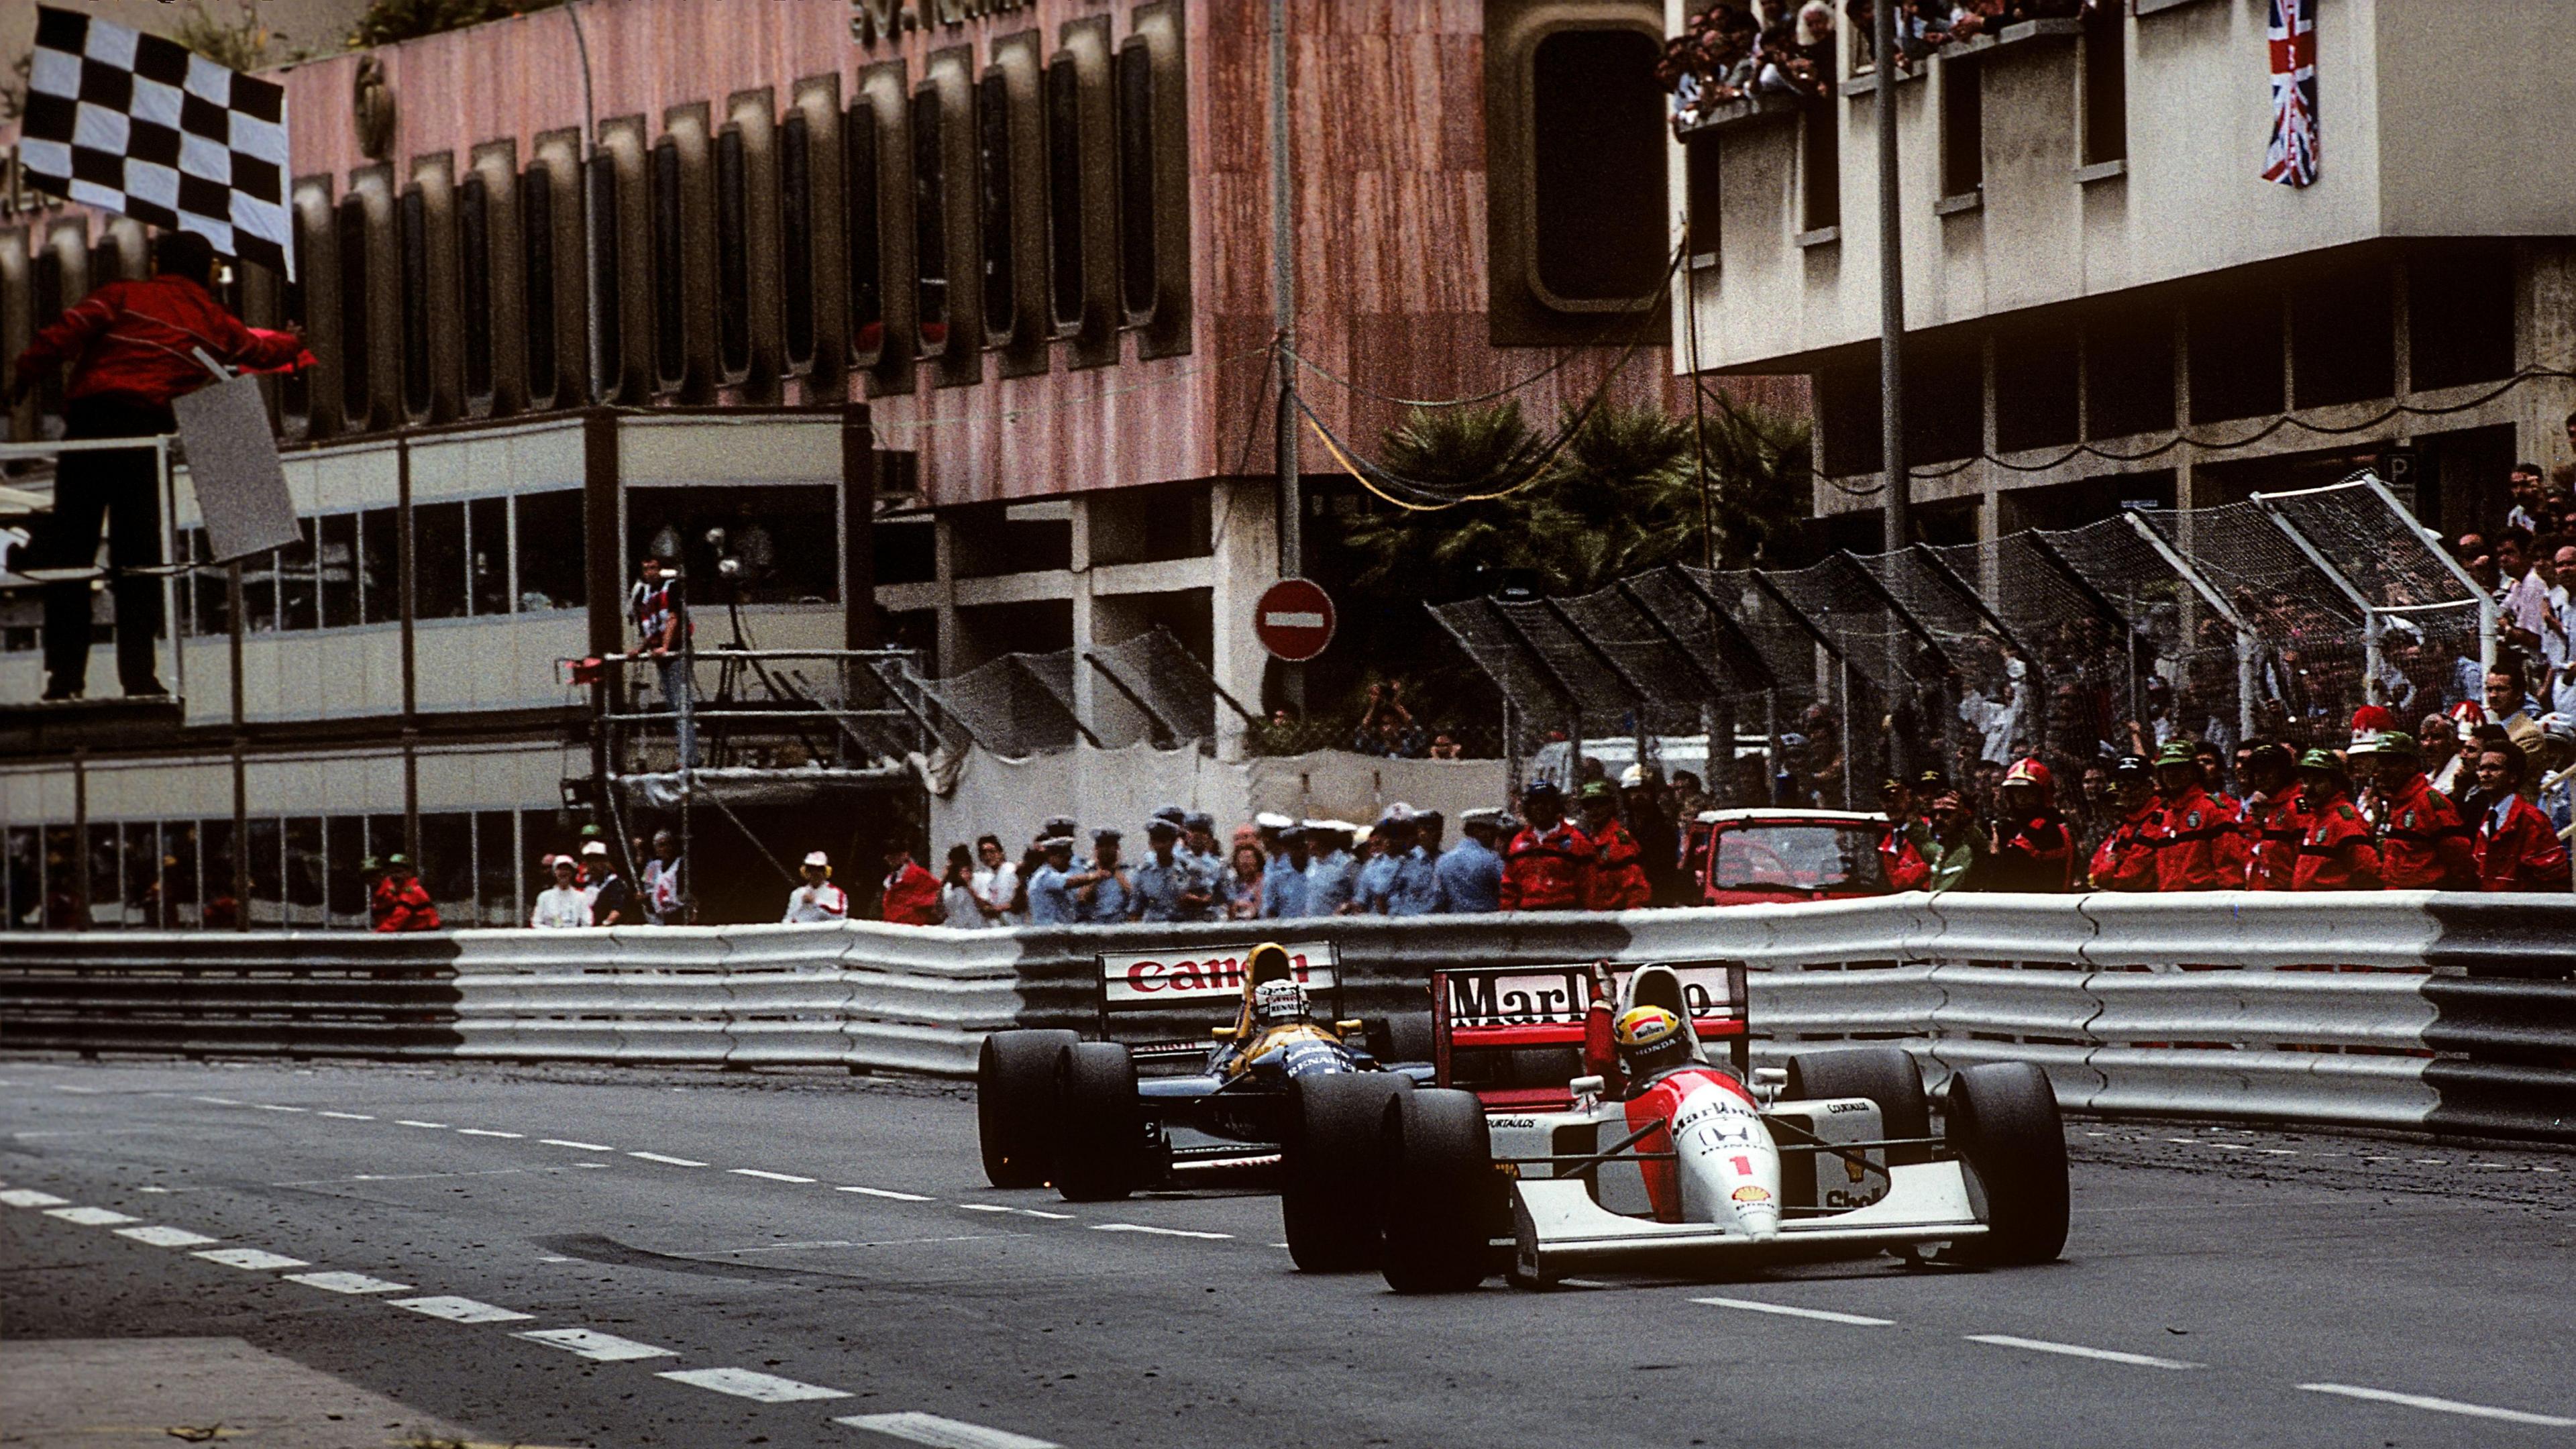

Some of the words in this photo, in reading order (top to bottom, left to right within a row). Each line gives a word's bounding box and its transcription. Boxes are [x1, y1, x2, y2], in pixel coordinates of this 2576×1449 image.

[1127, 953, 1309, 993] Cann
[1449, 974, 1711, 1026] Marlo
[1635, 1038, 1676, 1055] HONDA
[1729, 1156, 1753, 1175] 1
